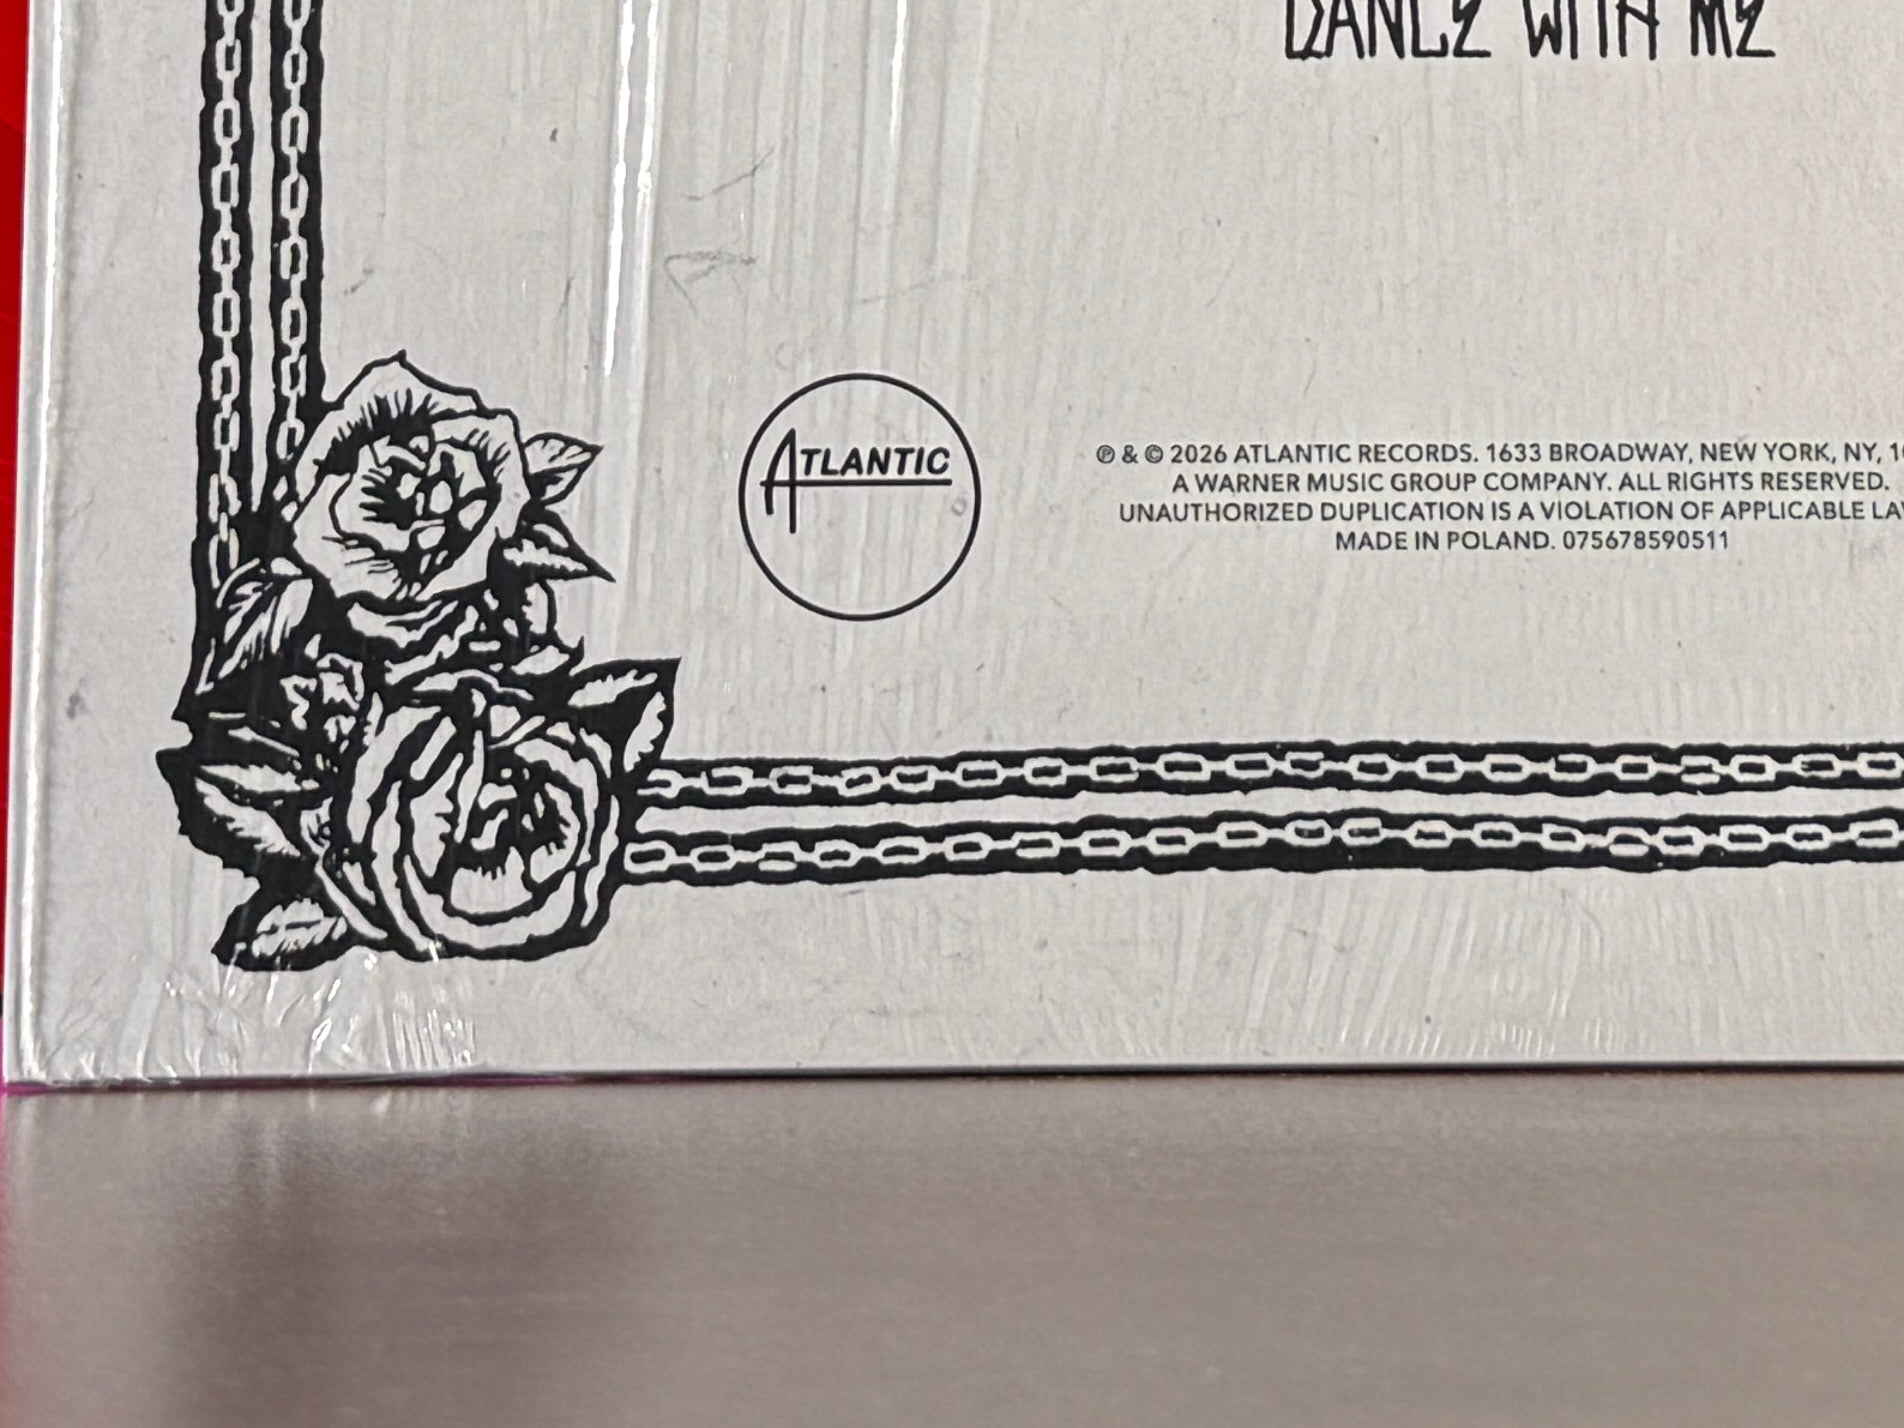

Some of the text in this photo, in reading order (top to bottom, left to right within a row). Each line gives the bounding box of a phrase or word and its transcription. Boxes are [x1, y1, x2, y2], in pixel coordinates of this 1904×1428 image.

[1122, 445, 1138, 464] &
[1171, 444, 1227, 463] 2026
[1234, 444, 1351, 463] ATLANTIC
[1359, 443, 1478, 463] RECORDS.
[1487, 443, 1541, 462] 1633
[1550, 443, 1692, 464] BROADWAY,
[1701, 443, 1756, 461] NEW
[1763, 443, 1836, 464] YORK,
[1845, 443, 1881, 464] NY,
[760, 428, 952, 534] ATLANTIC
[1173, 472, 1889, 493] A WARNER MUSIC GROUP COMPANY. ALL RIGHTS RESERVED.
[1120, 503, 1313, 522] UNAUTHORIZED
[1321, 502, 1483, 521] DUPLICATION
[1492, 502, 1511, 521] IS
[1518, 502, 1534, 520] A
[1540, 501, 1673, 520] VIOLATION
[1681, 501, 1713, 520] OF
[1721, 501, 1865, 520] APPLICABLE
[1336, 530, 1727, 550] MADE IN POLAND. 075678590511
